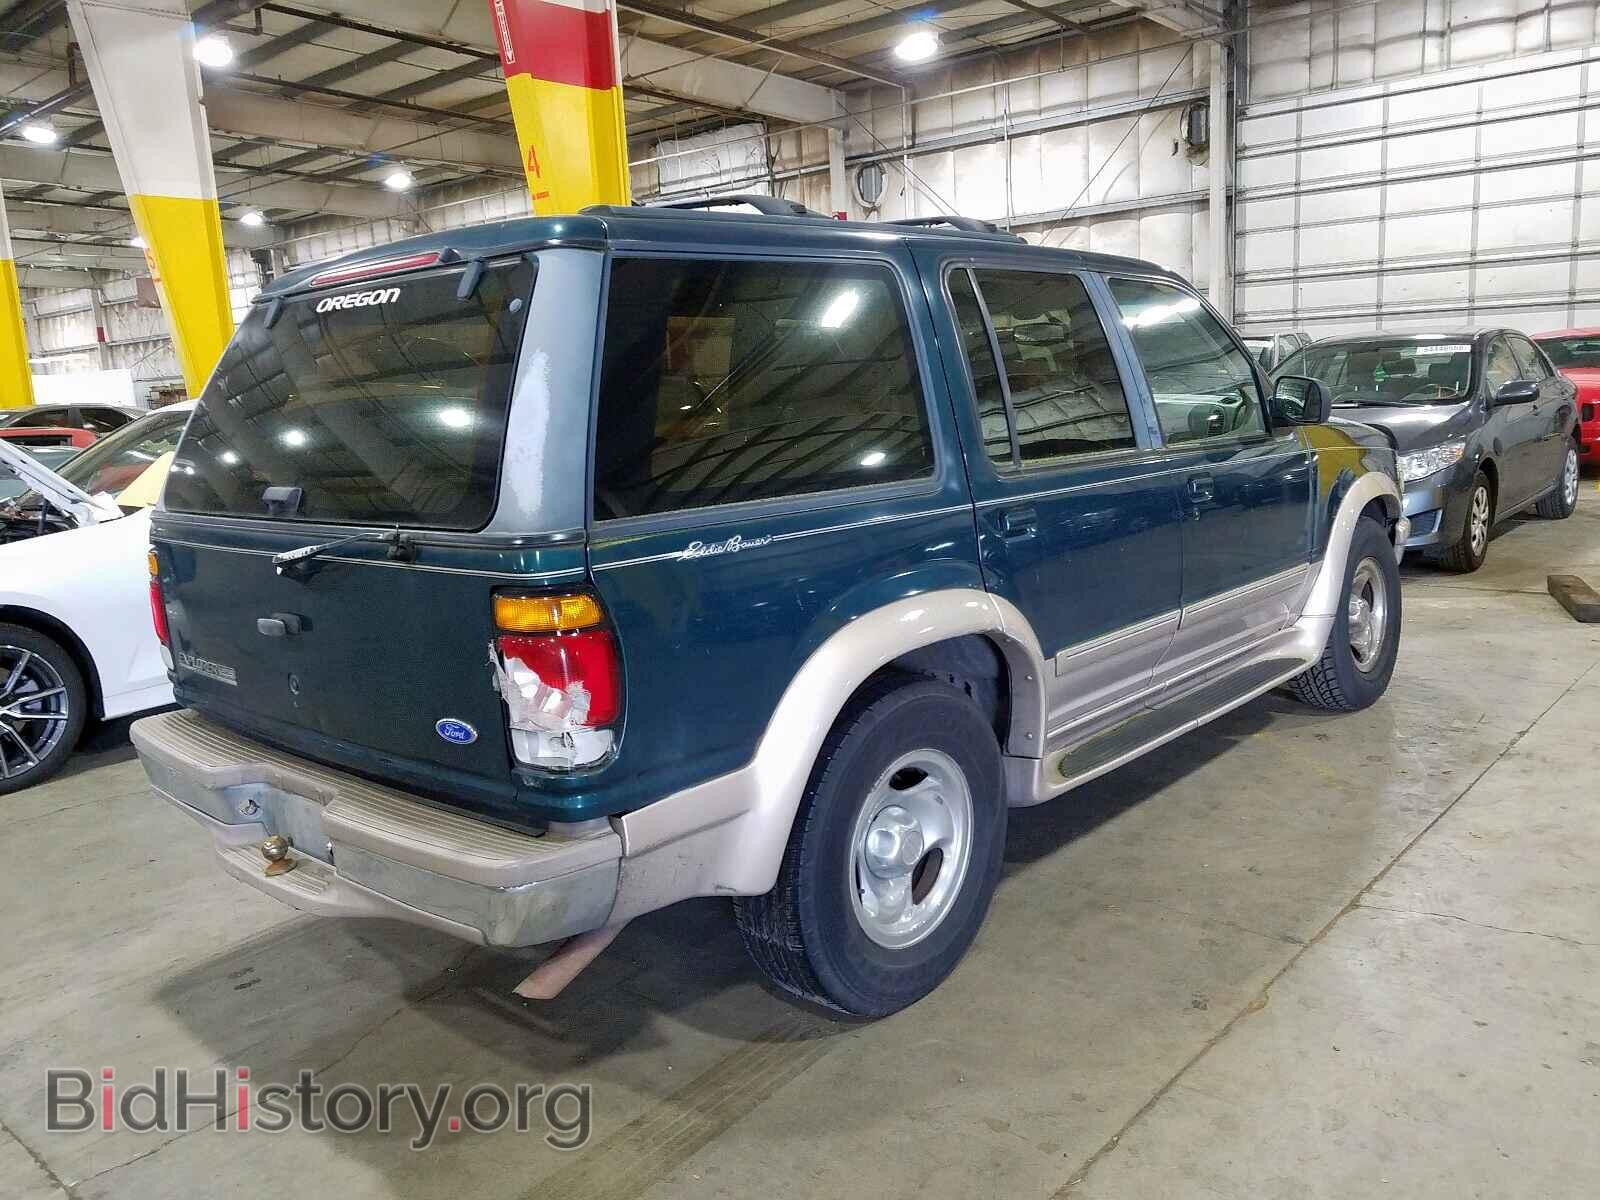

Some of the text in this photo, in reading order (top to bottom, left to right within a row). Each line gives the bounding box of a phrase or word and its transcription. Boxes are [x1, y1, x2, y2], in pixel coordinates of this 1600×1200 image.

[528, 144, 541, 178] 4
[315, 287, 400, 313] OREGON
[676, 534, 772, 562] Eddie Bauer
